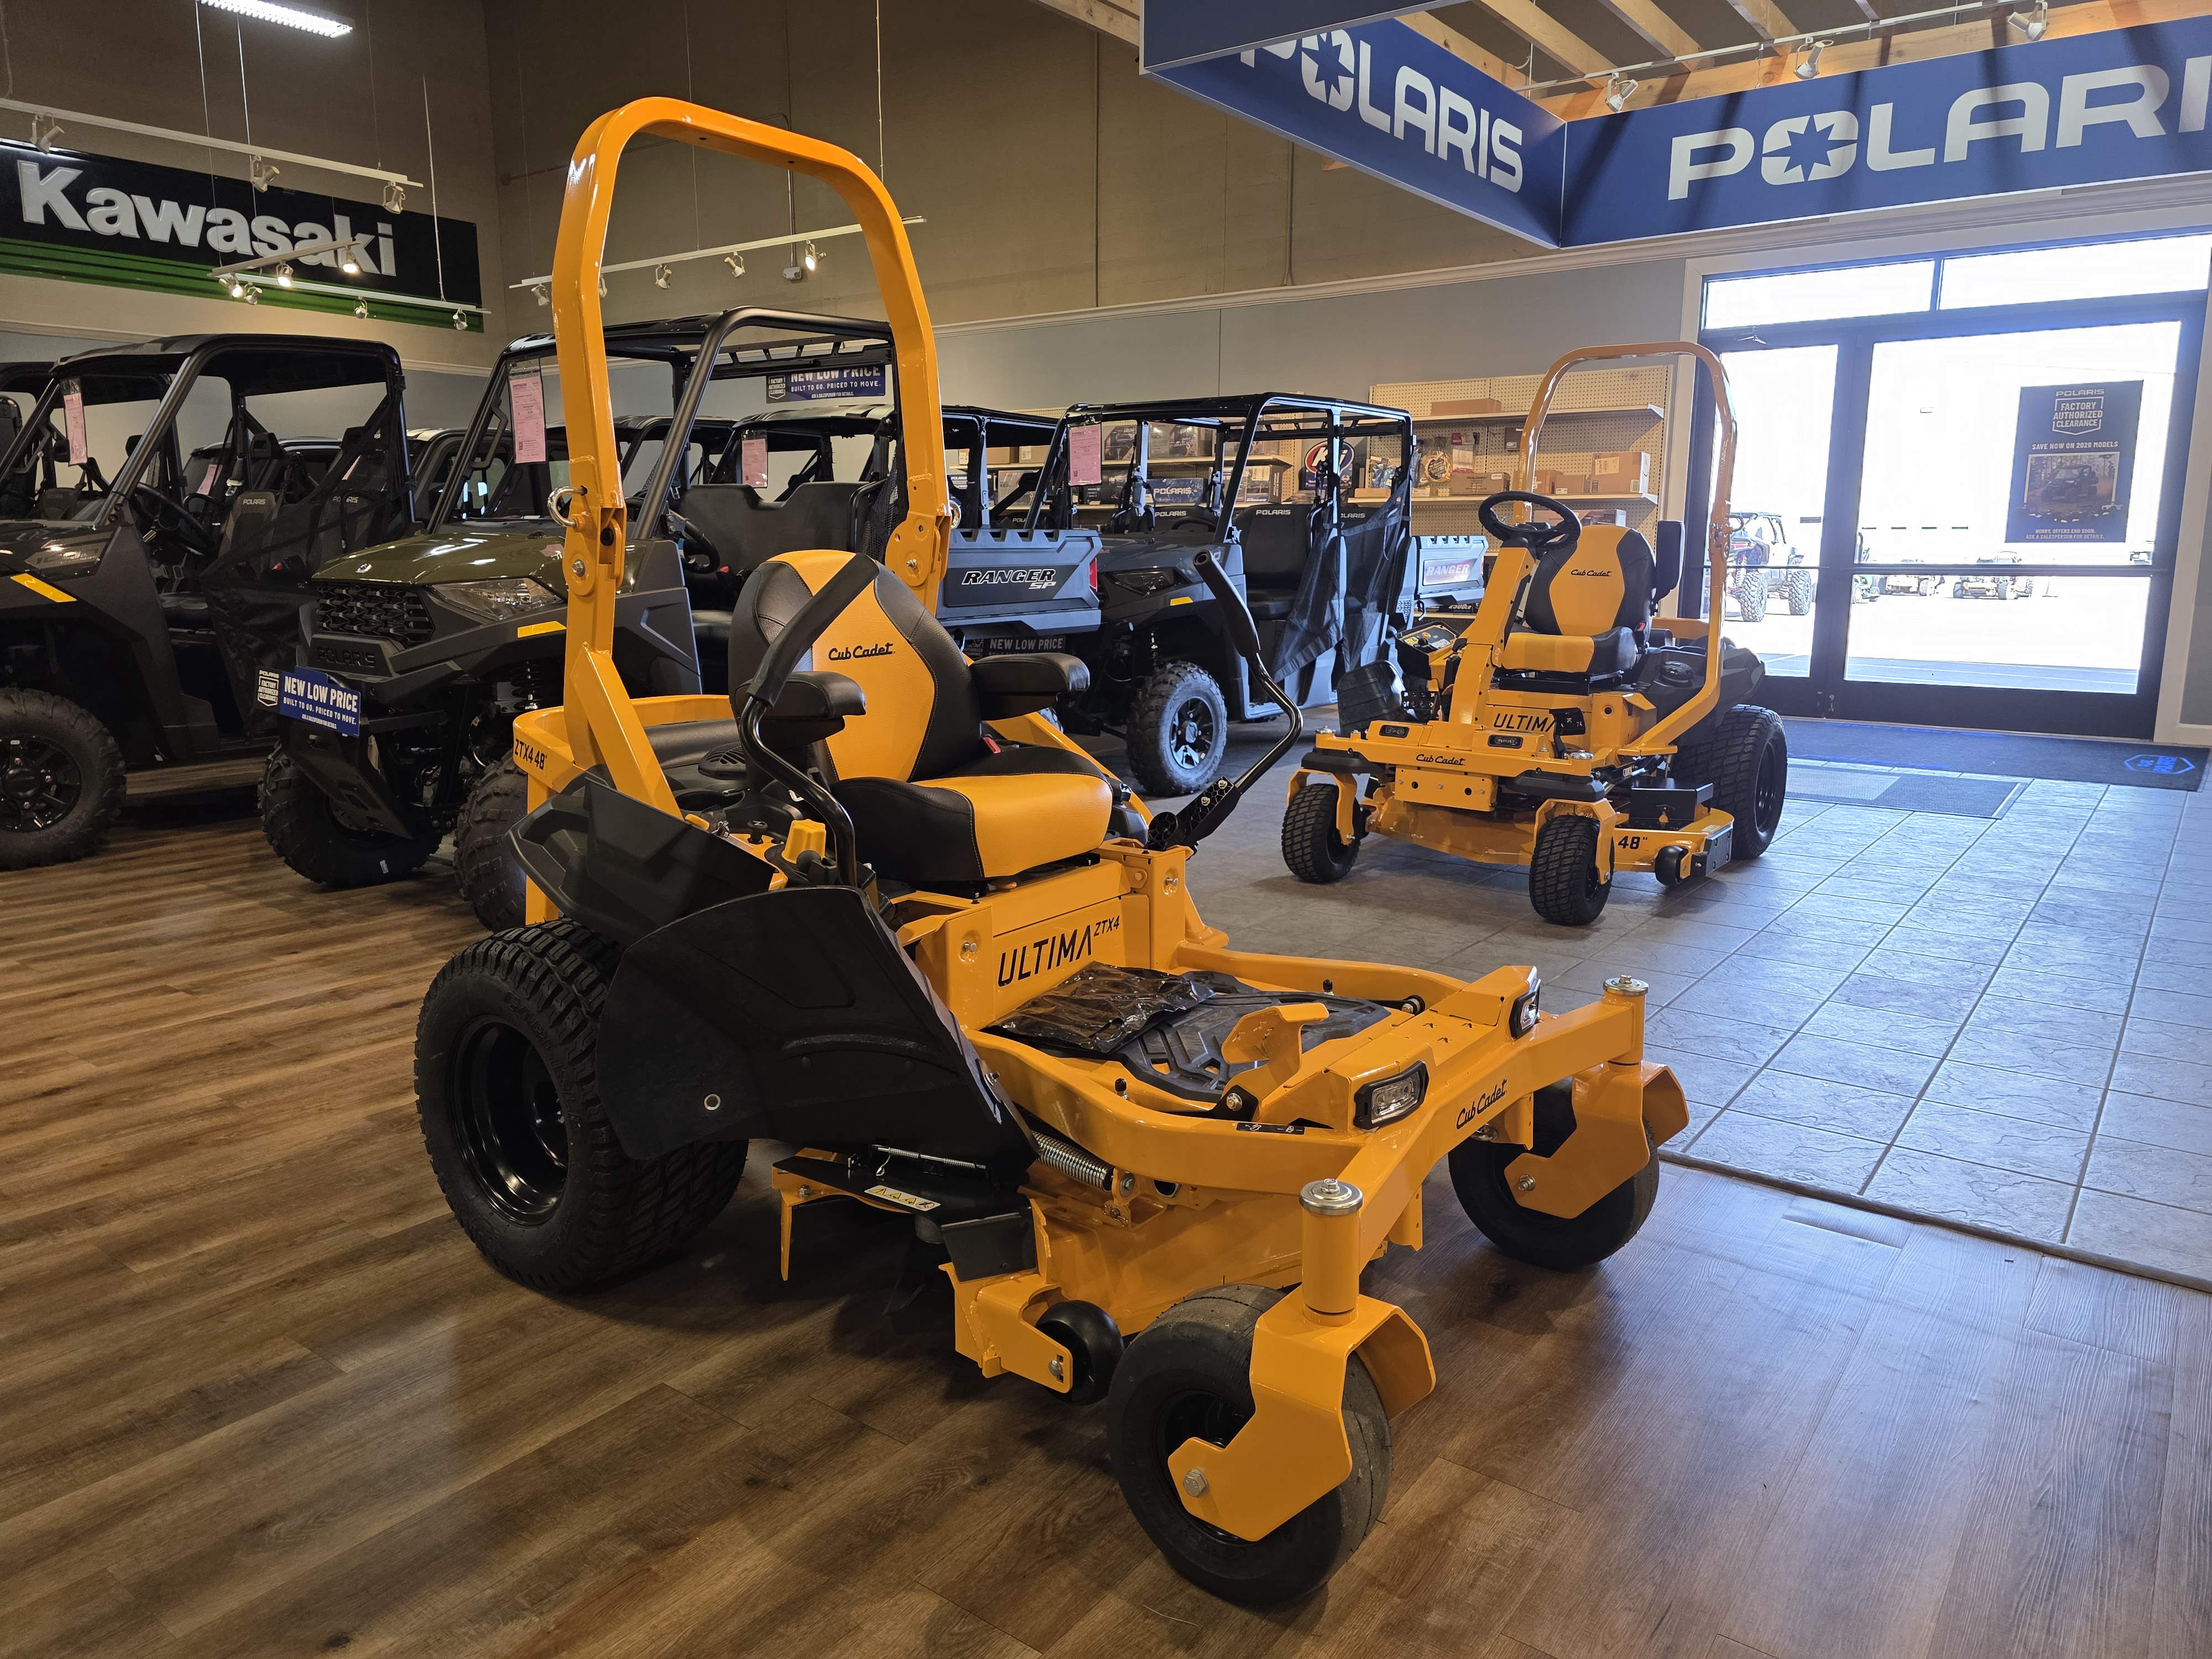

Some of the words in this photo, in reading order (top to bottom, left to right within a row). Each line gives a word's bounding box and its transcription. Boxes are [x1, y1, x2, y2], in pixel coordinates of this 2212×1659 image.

[17, 159, 397, 277] Kawasaki
[791, 372, 813, 383] NEW
[817, 369, 839, 379] LOW
[843, 366, 881, 378] PRICE
[2060, 402, 2096, 411] FACTORY
[2053, 410, 2103, 420] AUTHORIZED
[2056, 419, 2098, 427] CLEARANCE
[1153, 487, 1192, 495] POLARIS
[1426, 564, 1470, 576] RANGER
[961, 568, 1056, 585] RANGER
[1029, 581, 1057, 589] SP
[989, 638, 1013, 649] NEW
[1015, 639, 1036, 650] LOW
[1038, 638, 1063, 650] PRICE
[828, 646, 852, 661] Cub
[853, 642, 894, 659] Cadet
[259, 670, 279, 679] POLARIS
[261, 680, 276, 689] FACTORY
[284, 676, 305, 697] NEW
[307, 682, 328, 703] LOW
[330, 688, 358, 713] PRICE
[283, 697, 298, 707] BUILT
[299, 701, 305, 709] TO
[306, 703, 314, 712] GO.
[315, 706, 333, 718] PRICED
[334, 711, 341, 720] TO
[342, 714, 357, 725] MOVE.
[514, 738, 534, 764] ZTX4
[1416, 754, 1434, 763] Cub
[1435, 756, 1465, 765] Cadet
[1618, 836, 1648, 849] 48"
[998, 925, 1092, 987] ULTIMA
[1093, 915, 1120, 937] ZTX4
[1456, 1101, 1476, 1130] Cub
[1477, 1079, 1507, 1114] Cadet
